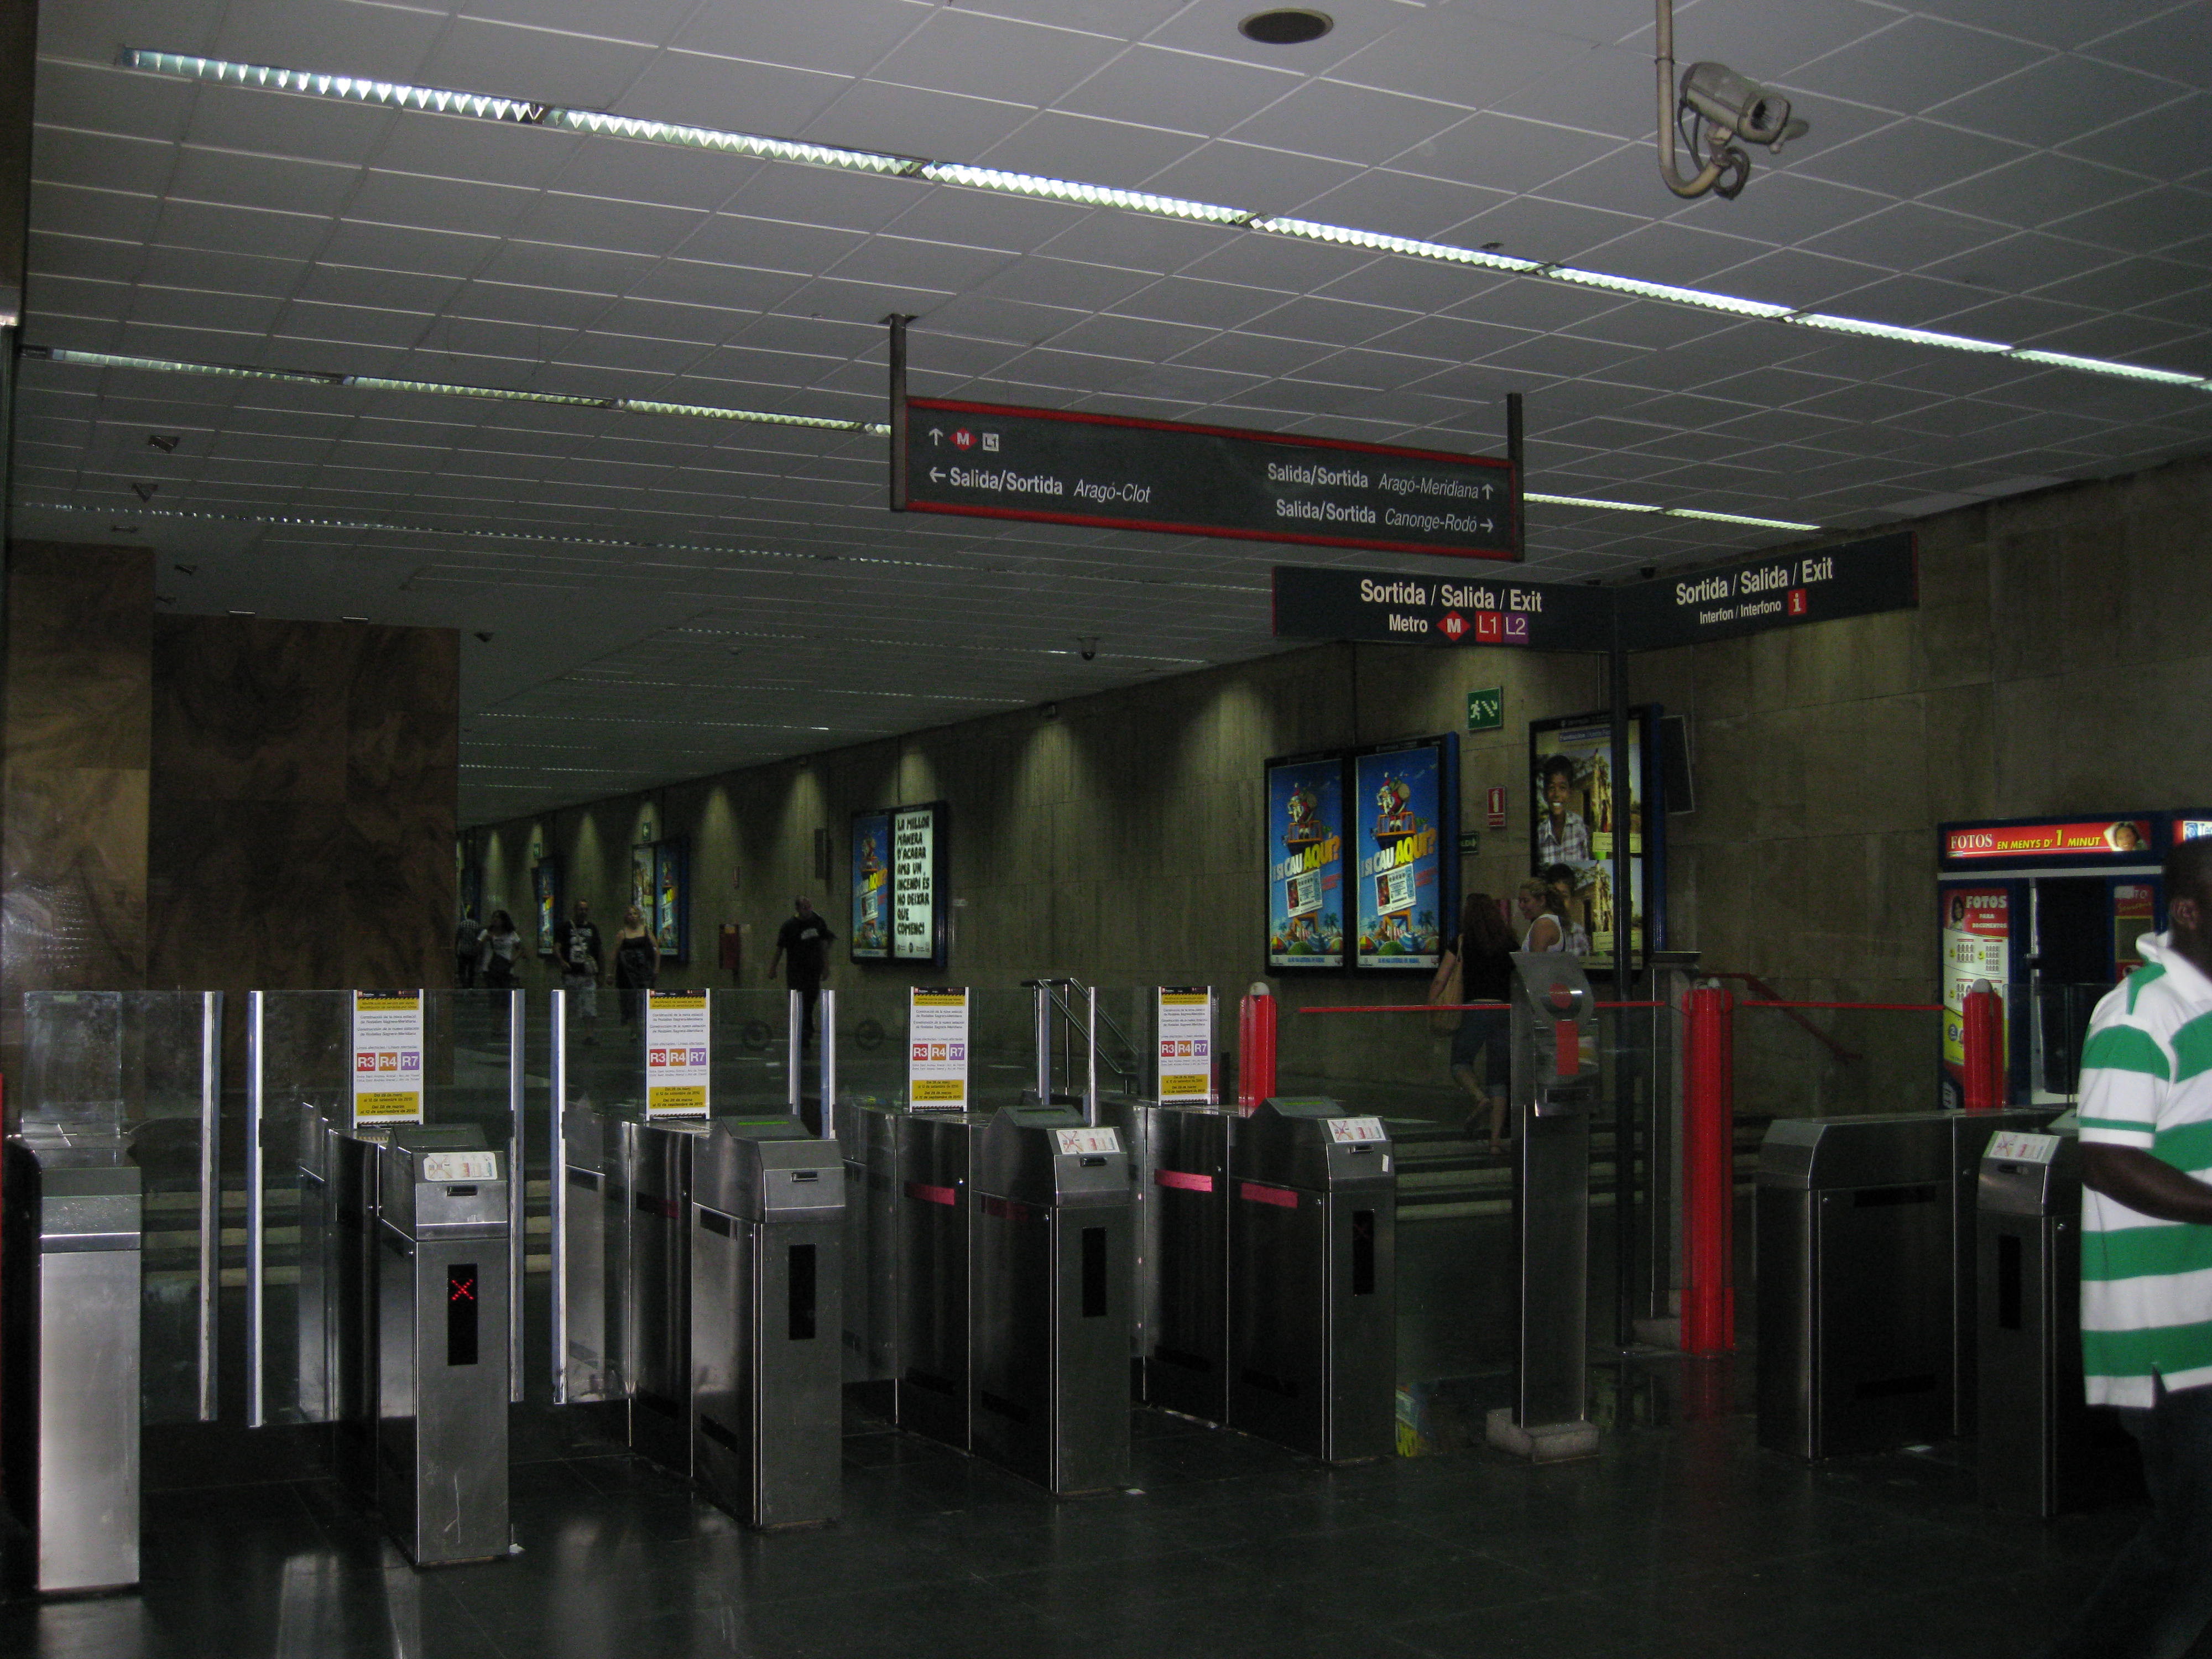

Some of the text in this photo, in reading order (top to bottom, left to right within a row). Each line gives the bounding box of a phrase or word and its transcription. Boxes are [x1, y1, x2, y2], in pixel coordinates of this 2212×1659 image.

[957, 433, 969, 445] M
[950, 467, 1151, 503] Salida/Sortida Aragó-Clot
[1267, 463, 1479, 499] Salida/Sortida Aragó-Meridiana
[1276, 499, 1477, 533] Salida/Sortida Canonge-Rodó
[1676, 577, 1728, 606] Sortida
[1740, 566, 1788, 594] Salida
[1802, 557, 1834, 584] Exit
[1360, 579, 1426, 605] Sortida
[1441, 585, 1494, 609] Salida
[1510, 589, 1542, 612] Exit
[1699, 608, 1734, 624] Interfon
[1740, 599, 1782, 618] Interfono
[1389, 614, 1526, 635] Metro M L1 L2
[1950, 833, 1992, 849] FOTOS
[1997, 841, 2008, 849] EN
[2011, 839, 2041, 849] MENYS
[2056, 829, 2063, 846] 1
[2068, 837, 2101, 847] MINUT
[1374, 847, 1394, 872] CAU
[1965, 895, 2007, 908] FOTOS
[650, 1052, 705, 1063] R3 R4 R7
[914, 1047, 964, 1057] R3 R4 R7
[1162, 1044, 1207, 1053] R3 R4 R7
[358, 1056, 418, 1067] R3 R4 R7
